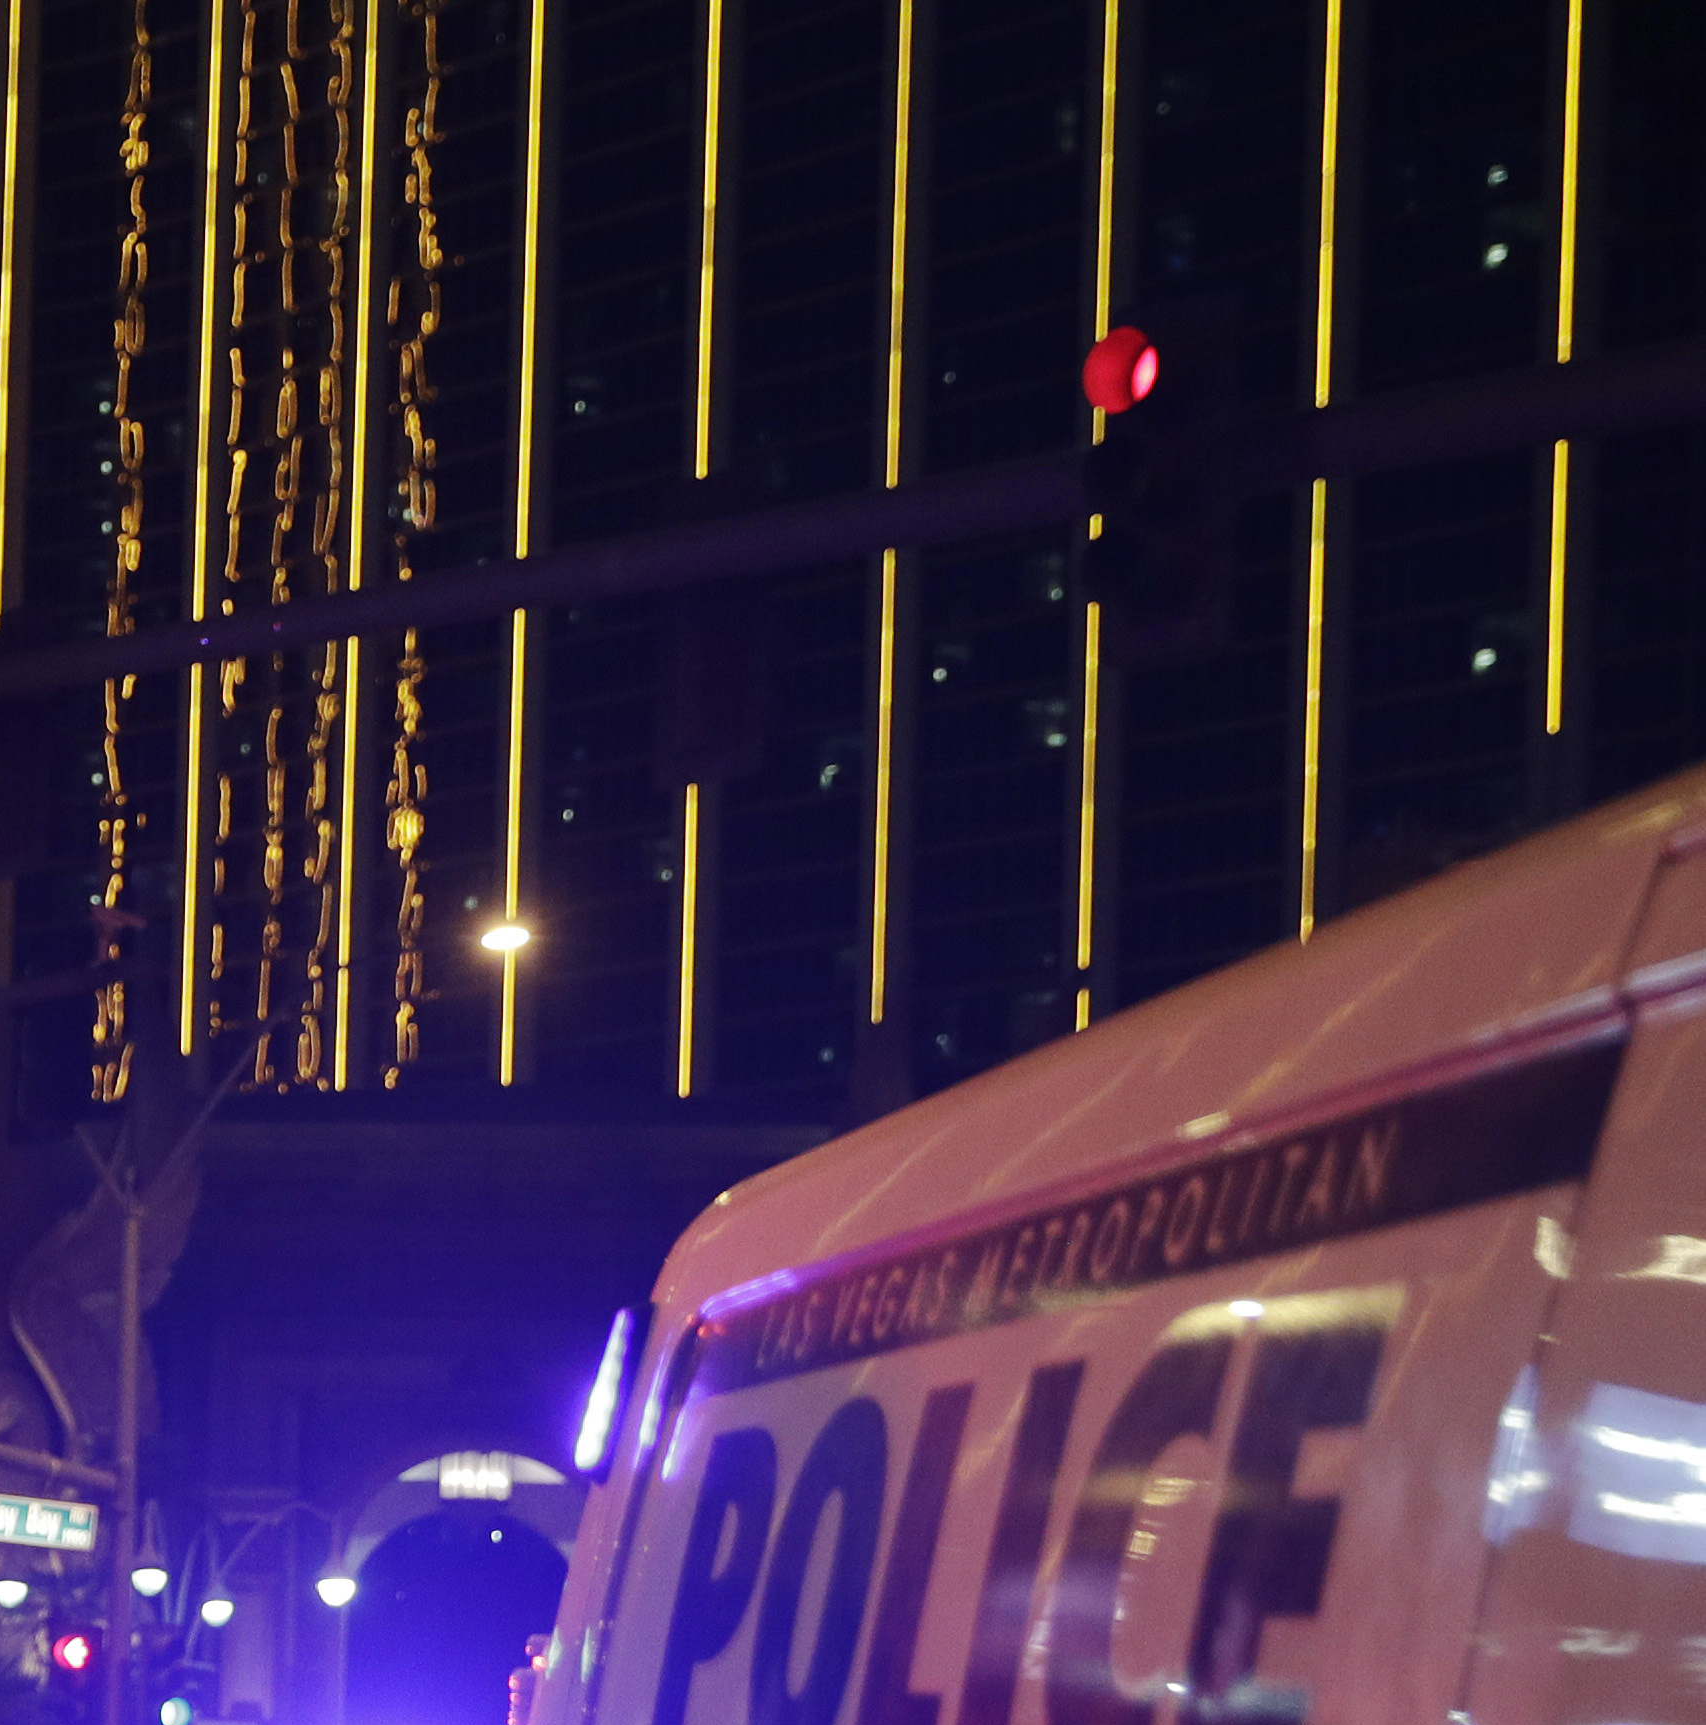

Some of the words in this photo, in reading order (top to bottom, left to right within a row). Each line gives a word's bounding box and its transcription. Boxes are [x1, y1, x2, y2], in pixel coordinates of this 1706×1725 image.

[753, 1289, 821, 1369] LAS
[831, 1251, 958, 1344] VEGAS
[965, 1121, 1397, 1320] METROPOLITAN
[25, 1502, 63, 1542] Bay
